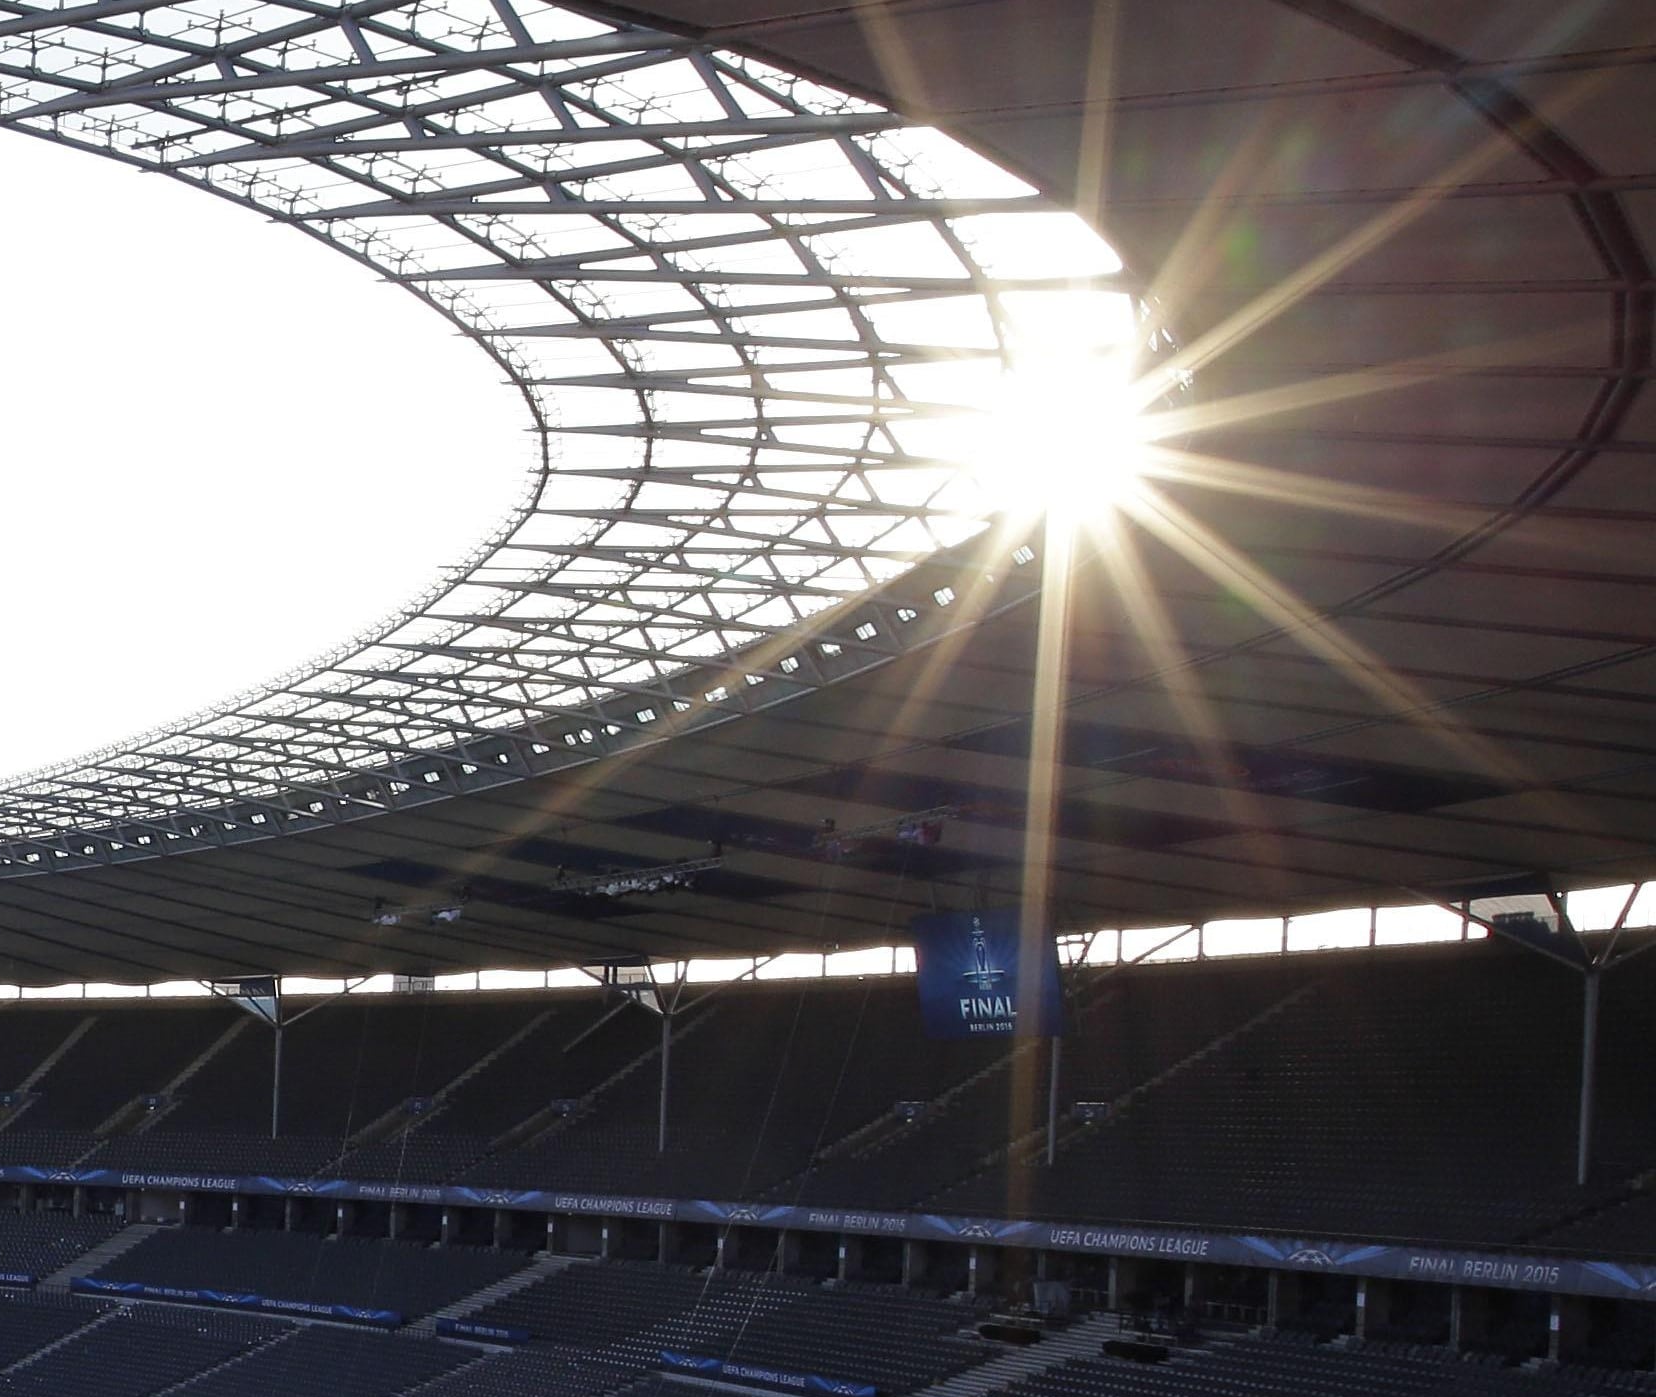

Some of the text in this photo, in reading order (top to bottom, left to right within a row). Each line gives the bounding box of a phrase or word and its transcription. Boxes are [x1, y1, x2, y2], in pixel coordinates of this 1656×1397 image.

[959, 996, 1018, 1020] FINAL
[122, 1174, 237, 1189] UEFA CHAMPIONS LEAGUE
[555, 1197, 673, 1215] UEFA CHAMPIONS LEAGUE
[843, 1215, 880, 1229] BERLIN
[1050, 1230, 1210, 1256] UEFA CHAMPIONS LEAGUE
[1408, 1256, 1560, 1285] FINAL BERLIN 2015
